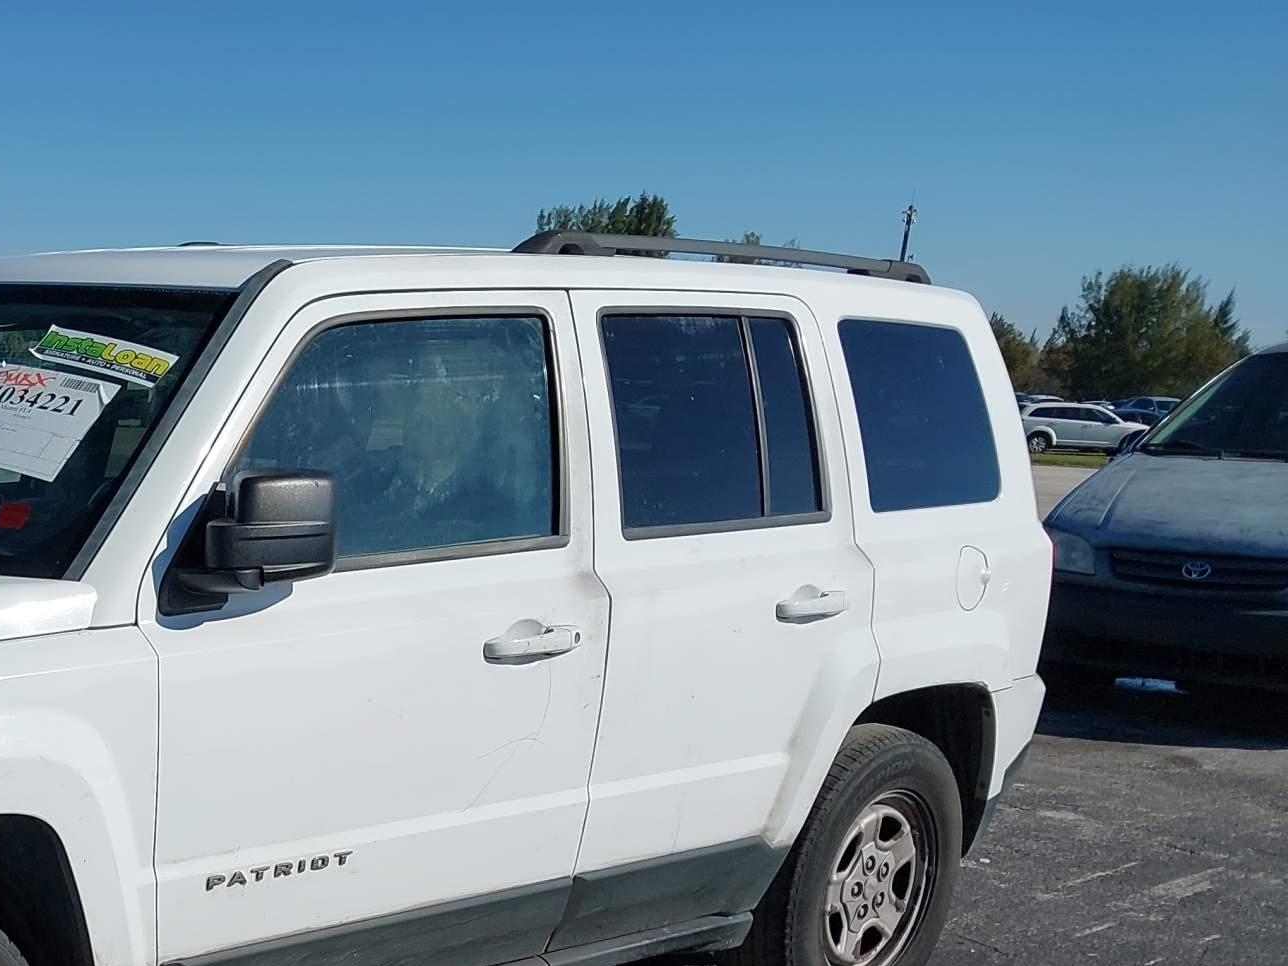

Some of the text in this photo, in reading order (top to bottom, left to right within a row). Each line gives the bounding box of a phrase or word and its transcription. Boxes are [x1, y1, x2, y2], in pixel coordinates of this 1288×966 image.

[40, 331, 170, 375] InstaLoan
[44, 349, 148, 380] SIGNATURE AUTO PERSONAL
[205, 850, 354, 892] PATRIOT
